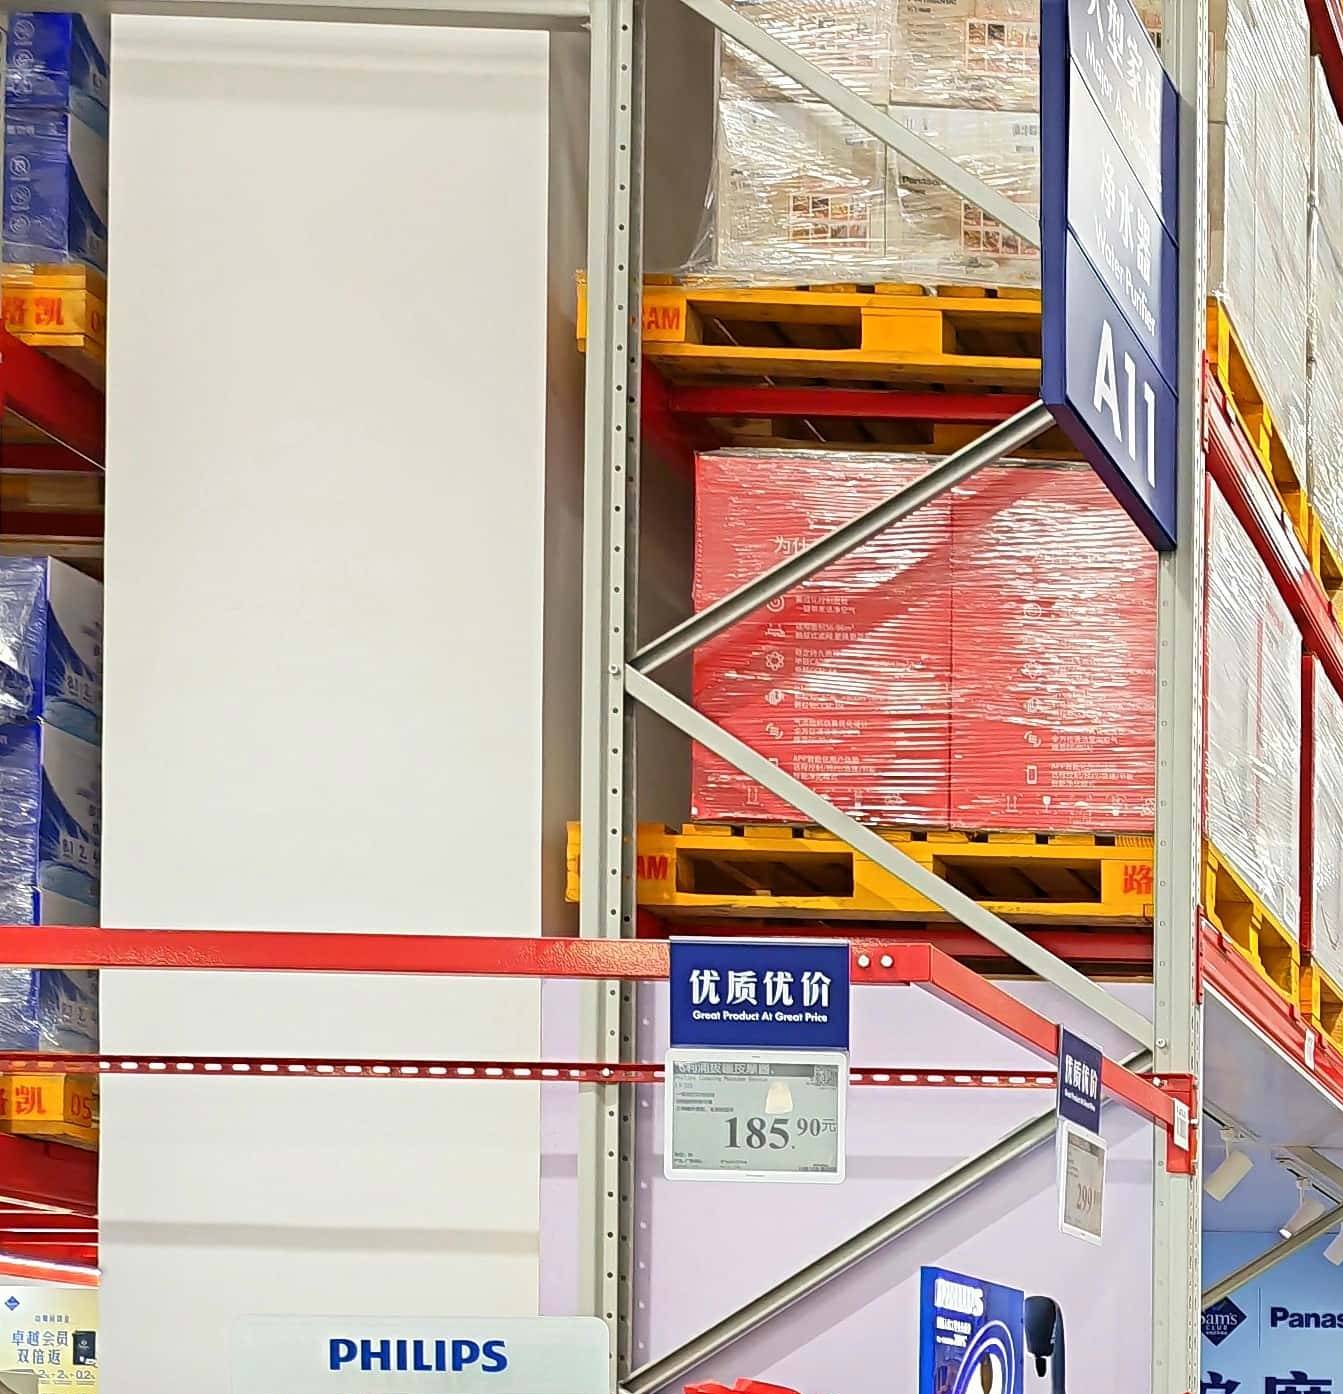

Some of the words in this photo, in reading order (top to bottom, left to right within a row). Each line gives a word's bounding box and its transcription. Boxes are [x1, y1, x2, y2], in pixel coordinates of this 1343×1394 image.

[1094, 214, 1125, 290] Water
[1124, 269, 1156, 337] Purifier
[1093, 319, 1156, 489] A11
[689, 969, 832, 1008] 优质优价
[692, 1010, 721, 1021] Great
[723, 1011, 759, 1022] Product
[761, 1012, 773, 1022] At
[775, 1012, 804, 1023] Great
[805, 1013, 828, 1024] Price
[1065, 1054, 1098, 1100] 优质优价
[12, 1330, 69, 1347] 卓越会员
[18, 1349, 61, 1365] 双倍返
[328, 1338, 509, 1373] PHILIPS
